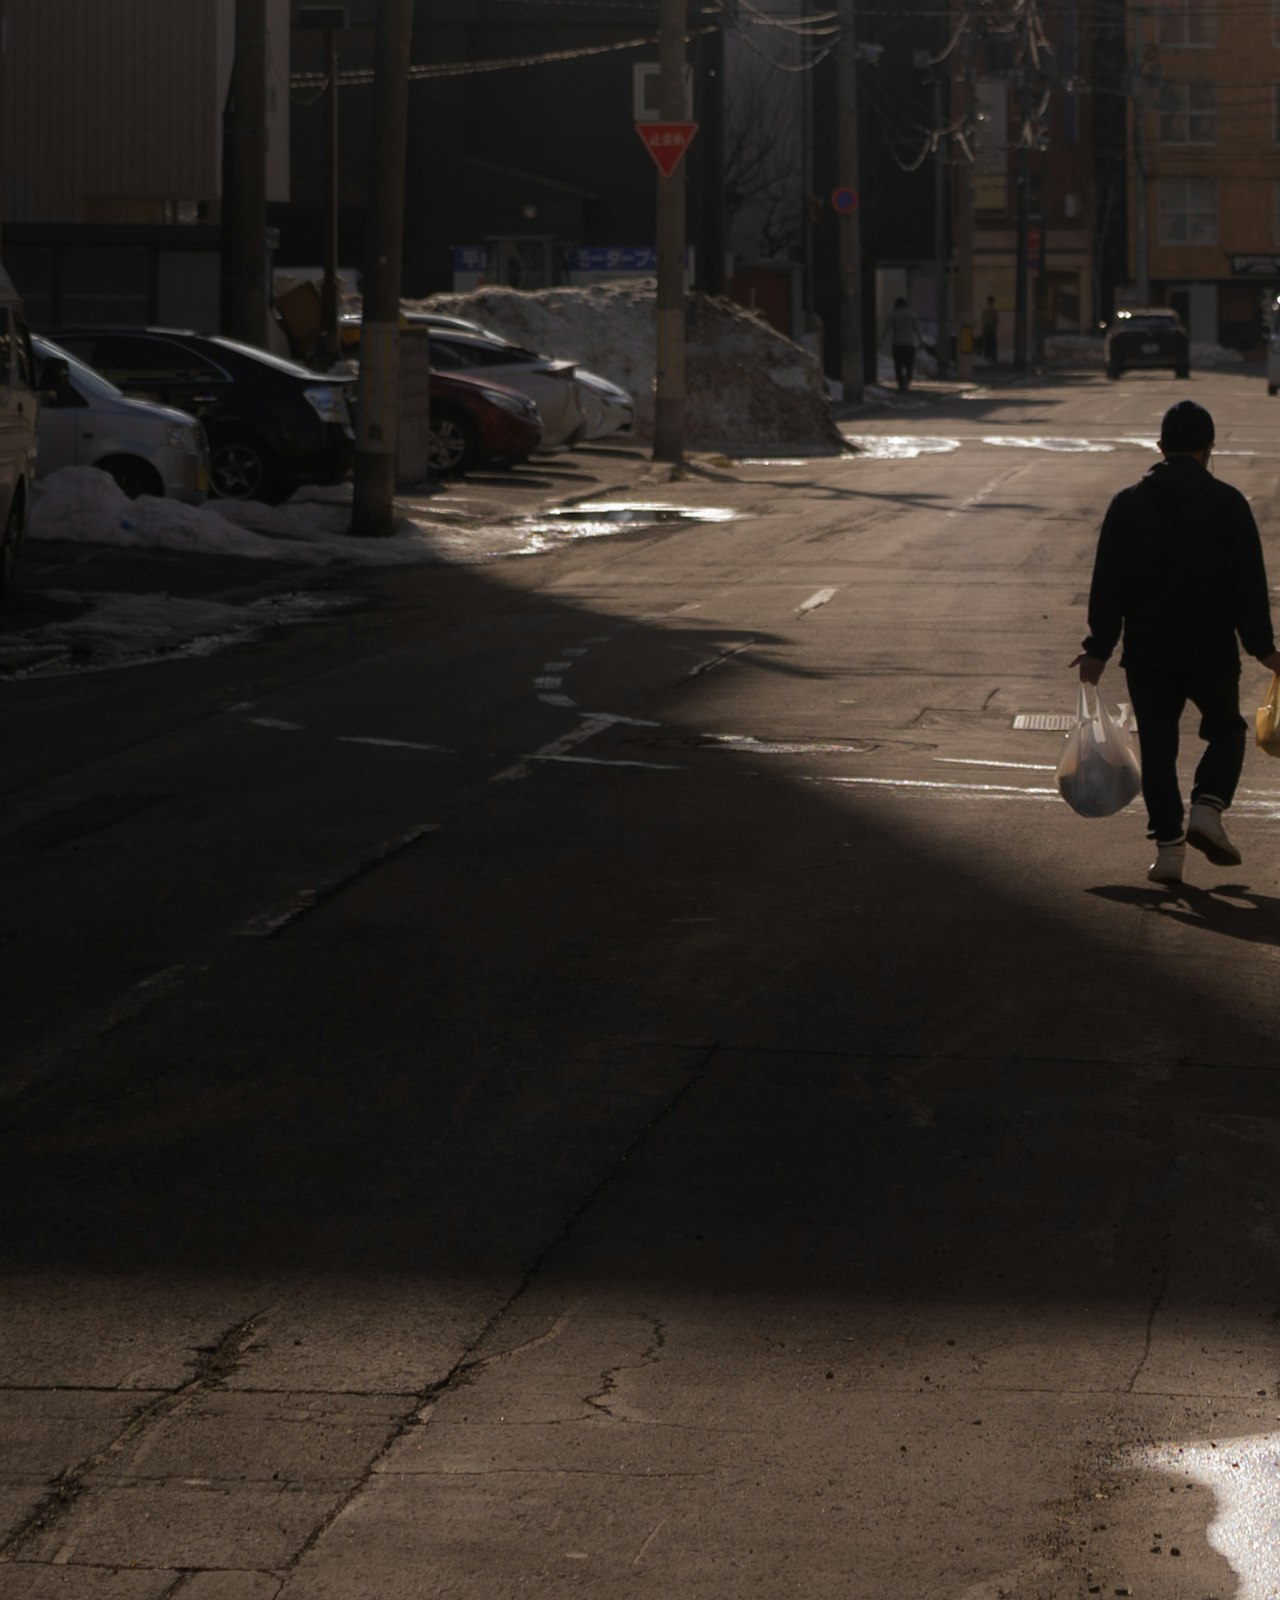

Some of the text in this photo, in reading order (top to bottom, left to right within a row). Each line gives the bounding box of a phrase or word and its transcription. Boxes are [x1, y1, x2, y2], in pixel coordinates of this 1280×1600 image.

[650, 132, 685, 147] 止まれ
[578, 248, 658, 268] モータープ
